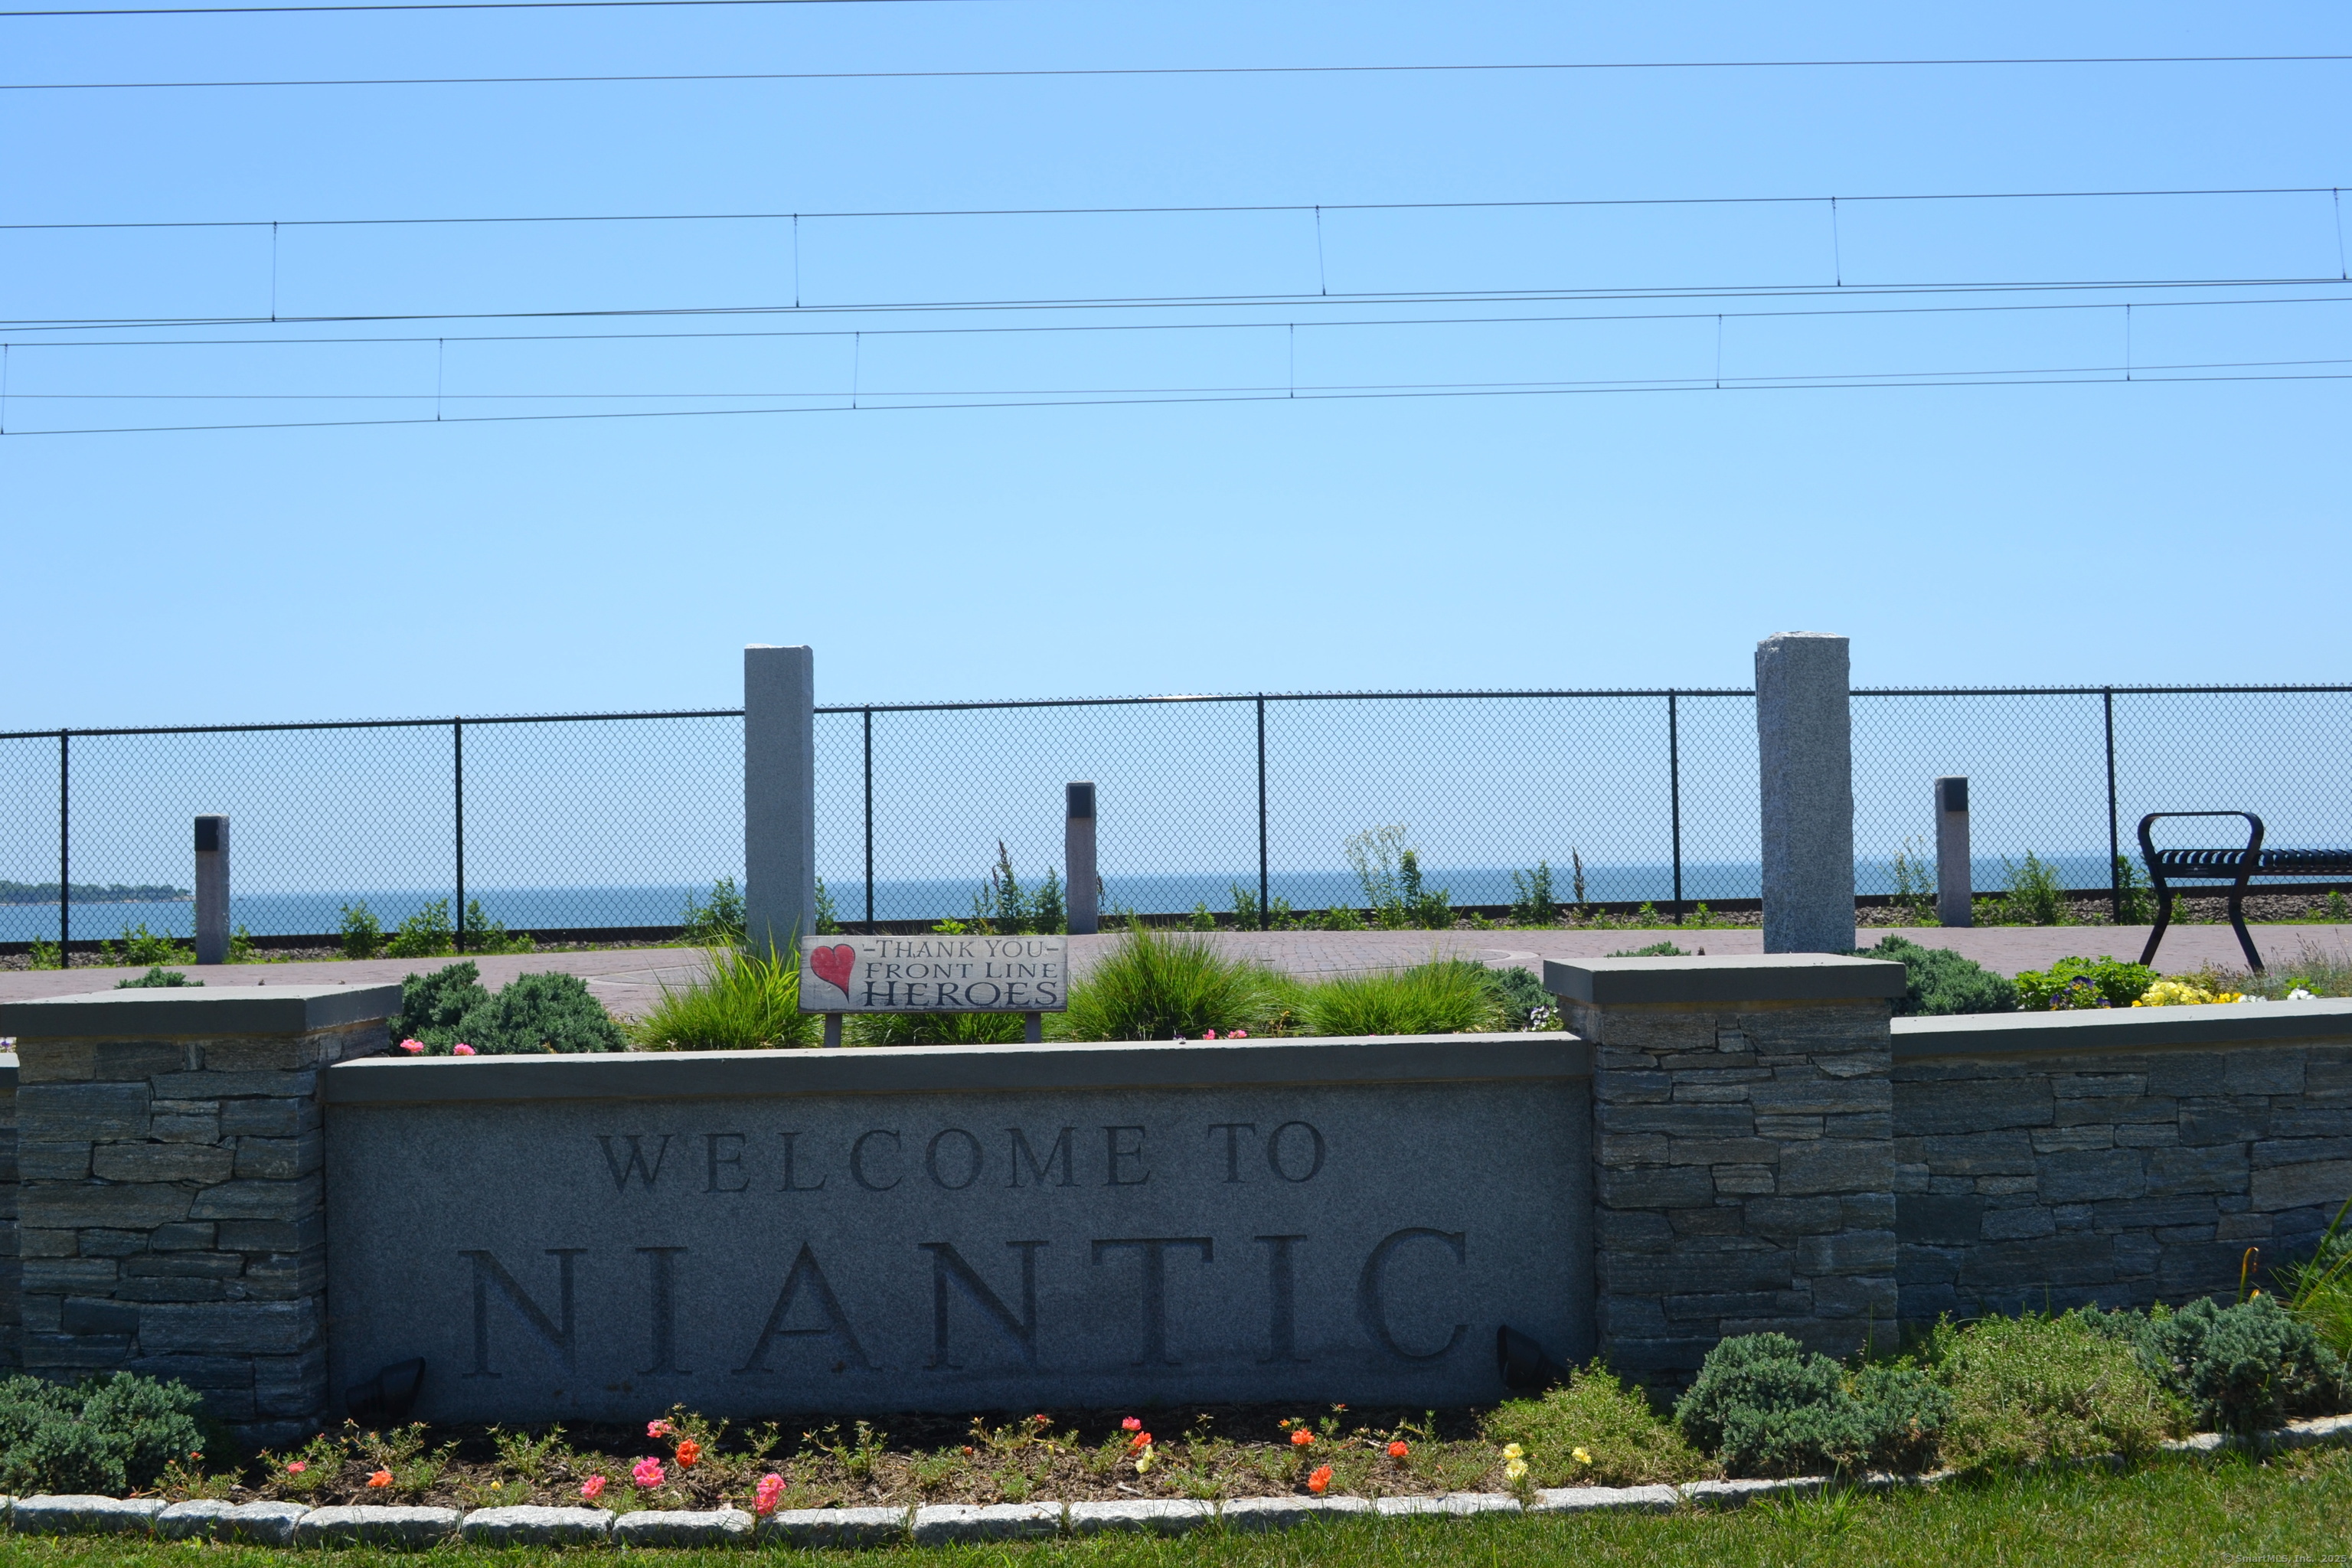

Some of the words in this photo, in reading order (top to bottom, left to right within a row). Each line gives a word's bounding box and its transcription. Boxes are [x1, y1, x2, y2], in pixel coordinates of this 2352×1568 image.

[861, 981, 1058, 1007] HEROES
[866, 962, 973, 979] FRONT
[985, 962, 1058, 978] LINE
[597, 1124, 1151, 1194] WELCOME
[1207, 1120, 1326, 1184] TO
[459, 1227, 1468, 1377] NIANTIC
